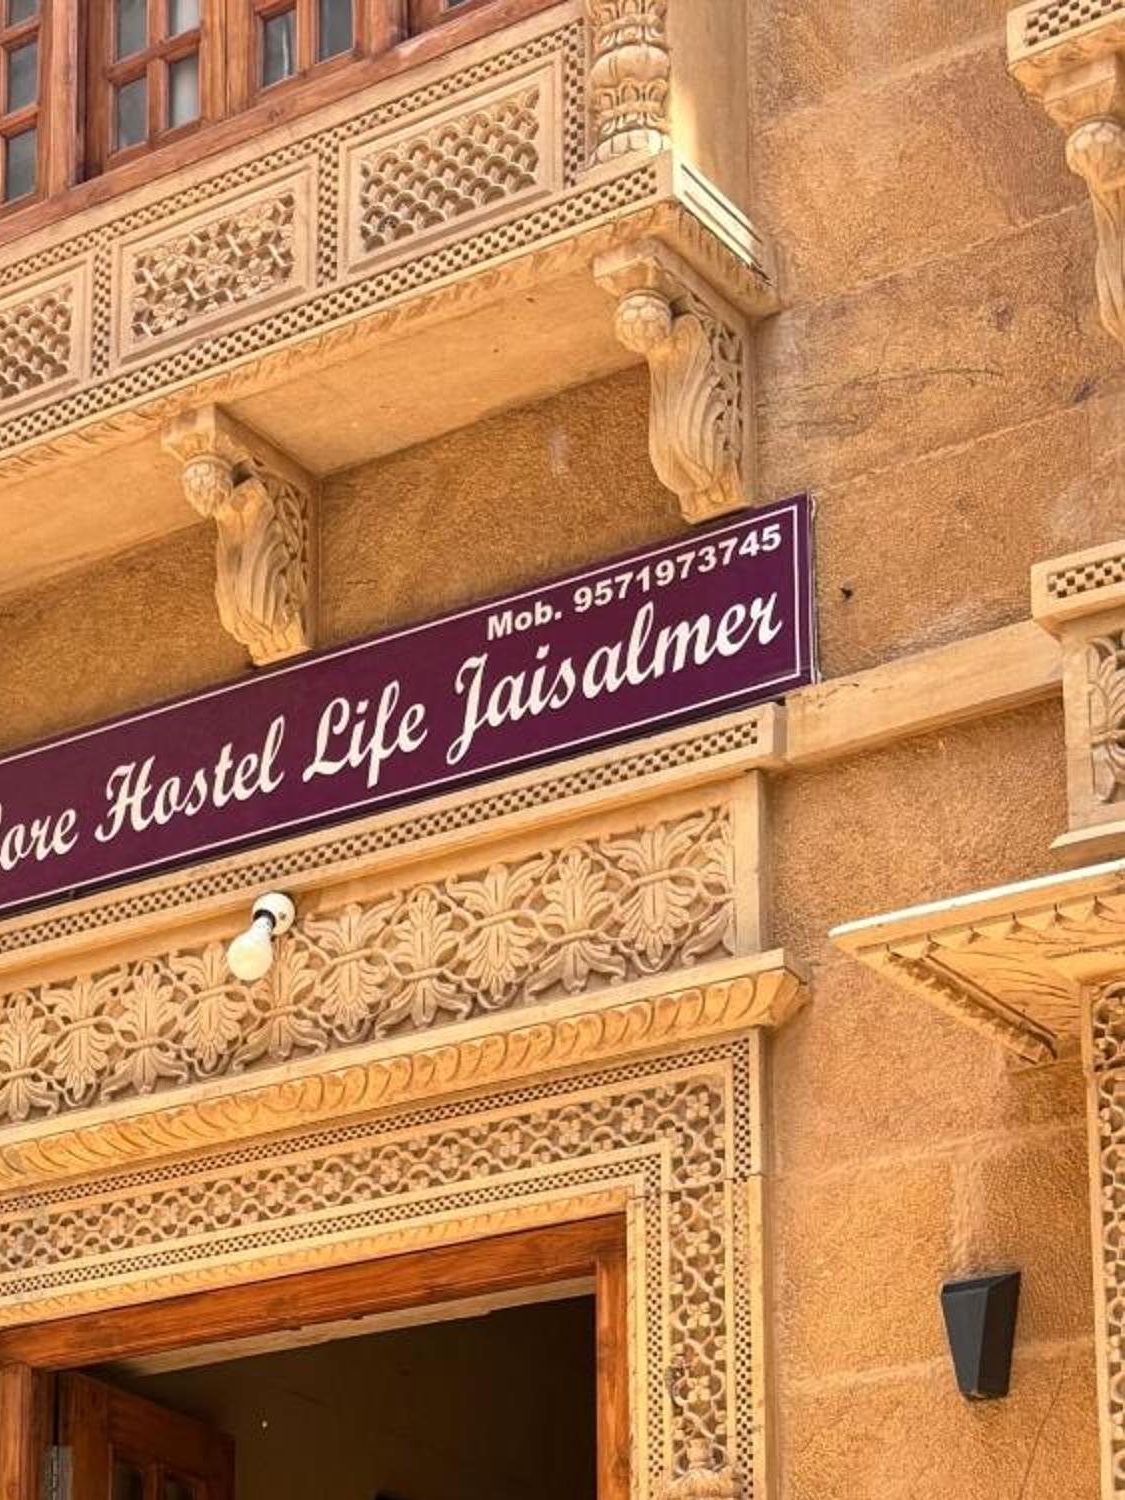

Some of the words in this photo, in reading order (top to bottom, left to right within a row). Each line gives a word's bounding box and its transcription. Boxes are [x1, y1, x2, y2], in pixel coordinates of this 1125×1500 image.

[486, 600, 563, 641] Mob.
[574, 523, 783, 614] 9571973745
[94, 715, 285, 842] Hostel
[302, 680, 428, 788] Life
[446, 592, 783, 765] Jaisalmer
